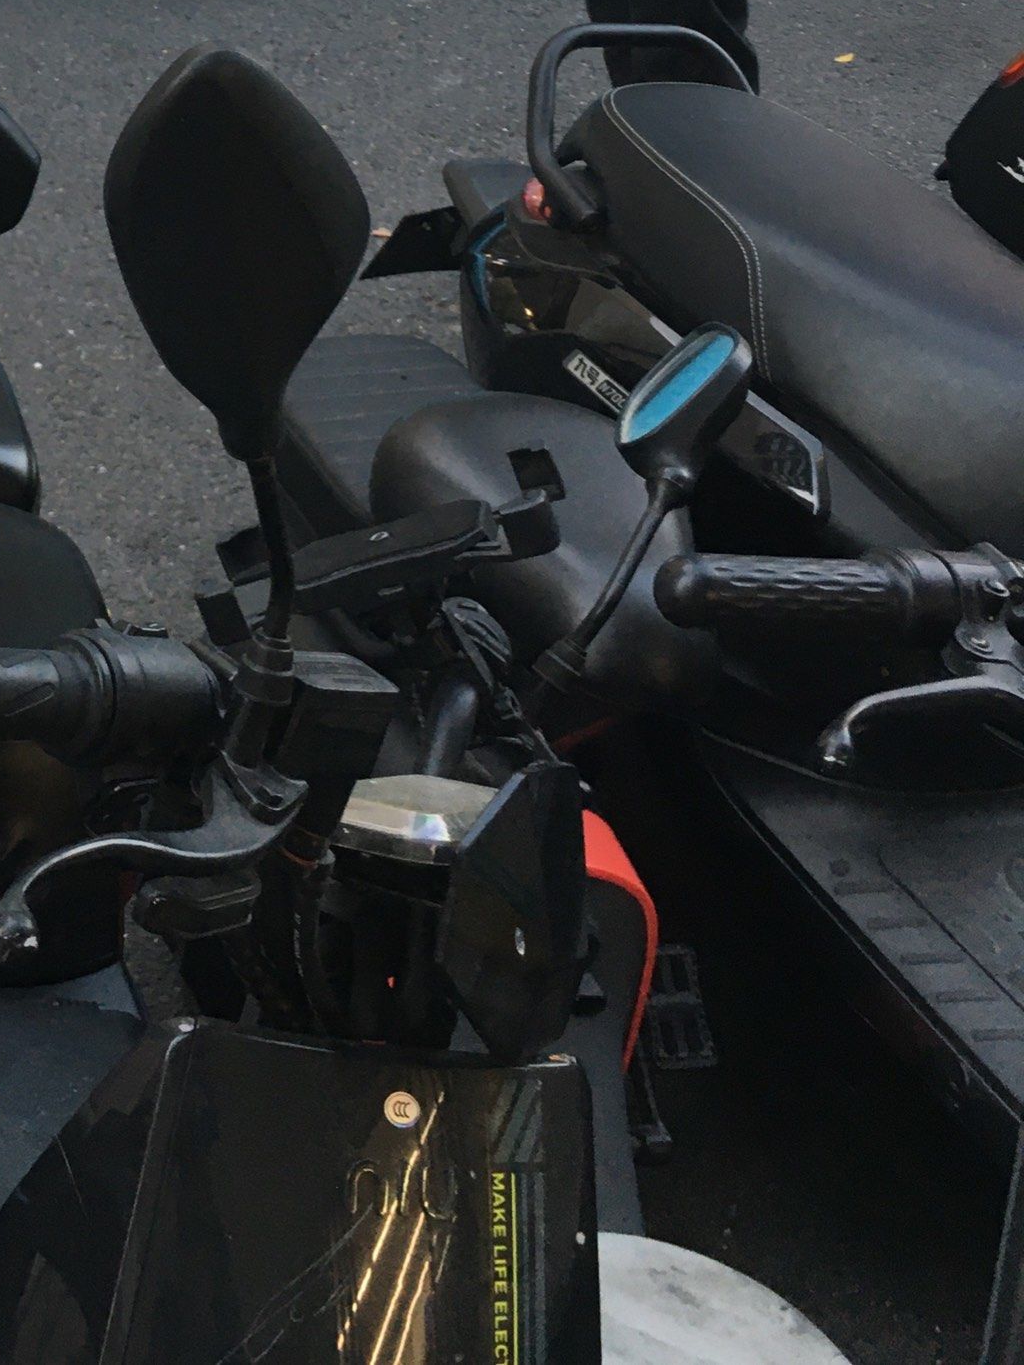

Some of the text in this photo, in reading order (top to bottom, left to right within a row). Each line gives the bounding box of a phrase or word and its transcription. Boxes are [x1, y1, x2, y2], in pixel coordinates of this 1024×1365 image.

[574, 357, 600, 386] 九号
[491, 1172, 507, 1238] MAKE
[493, 1245, 508, 1294] LIFE
